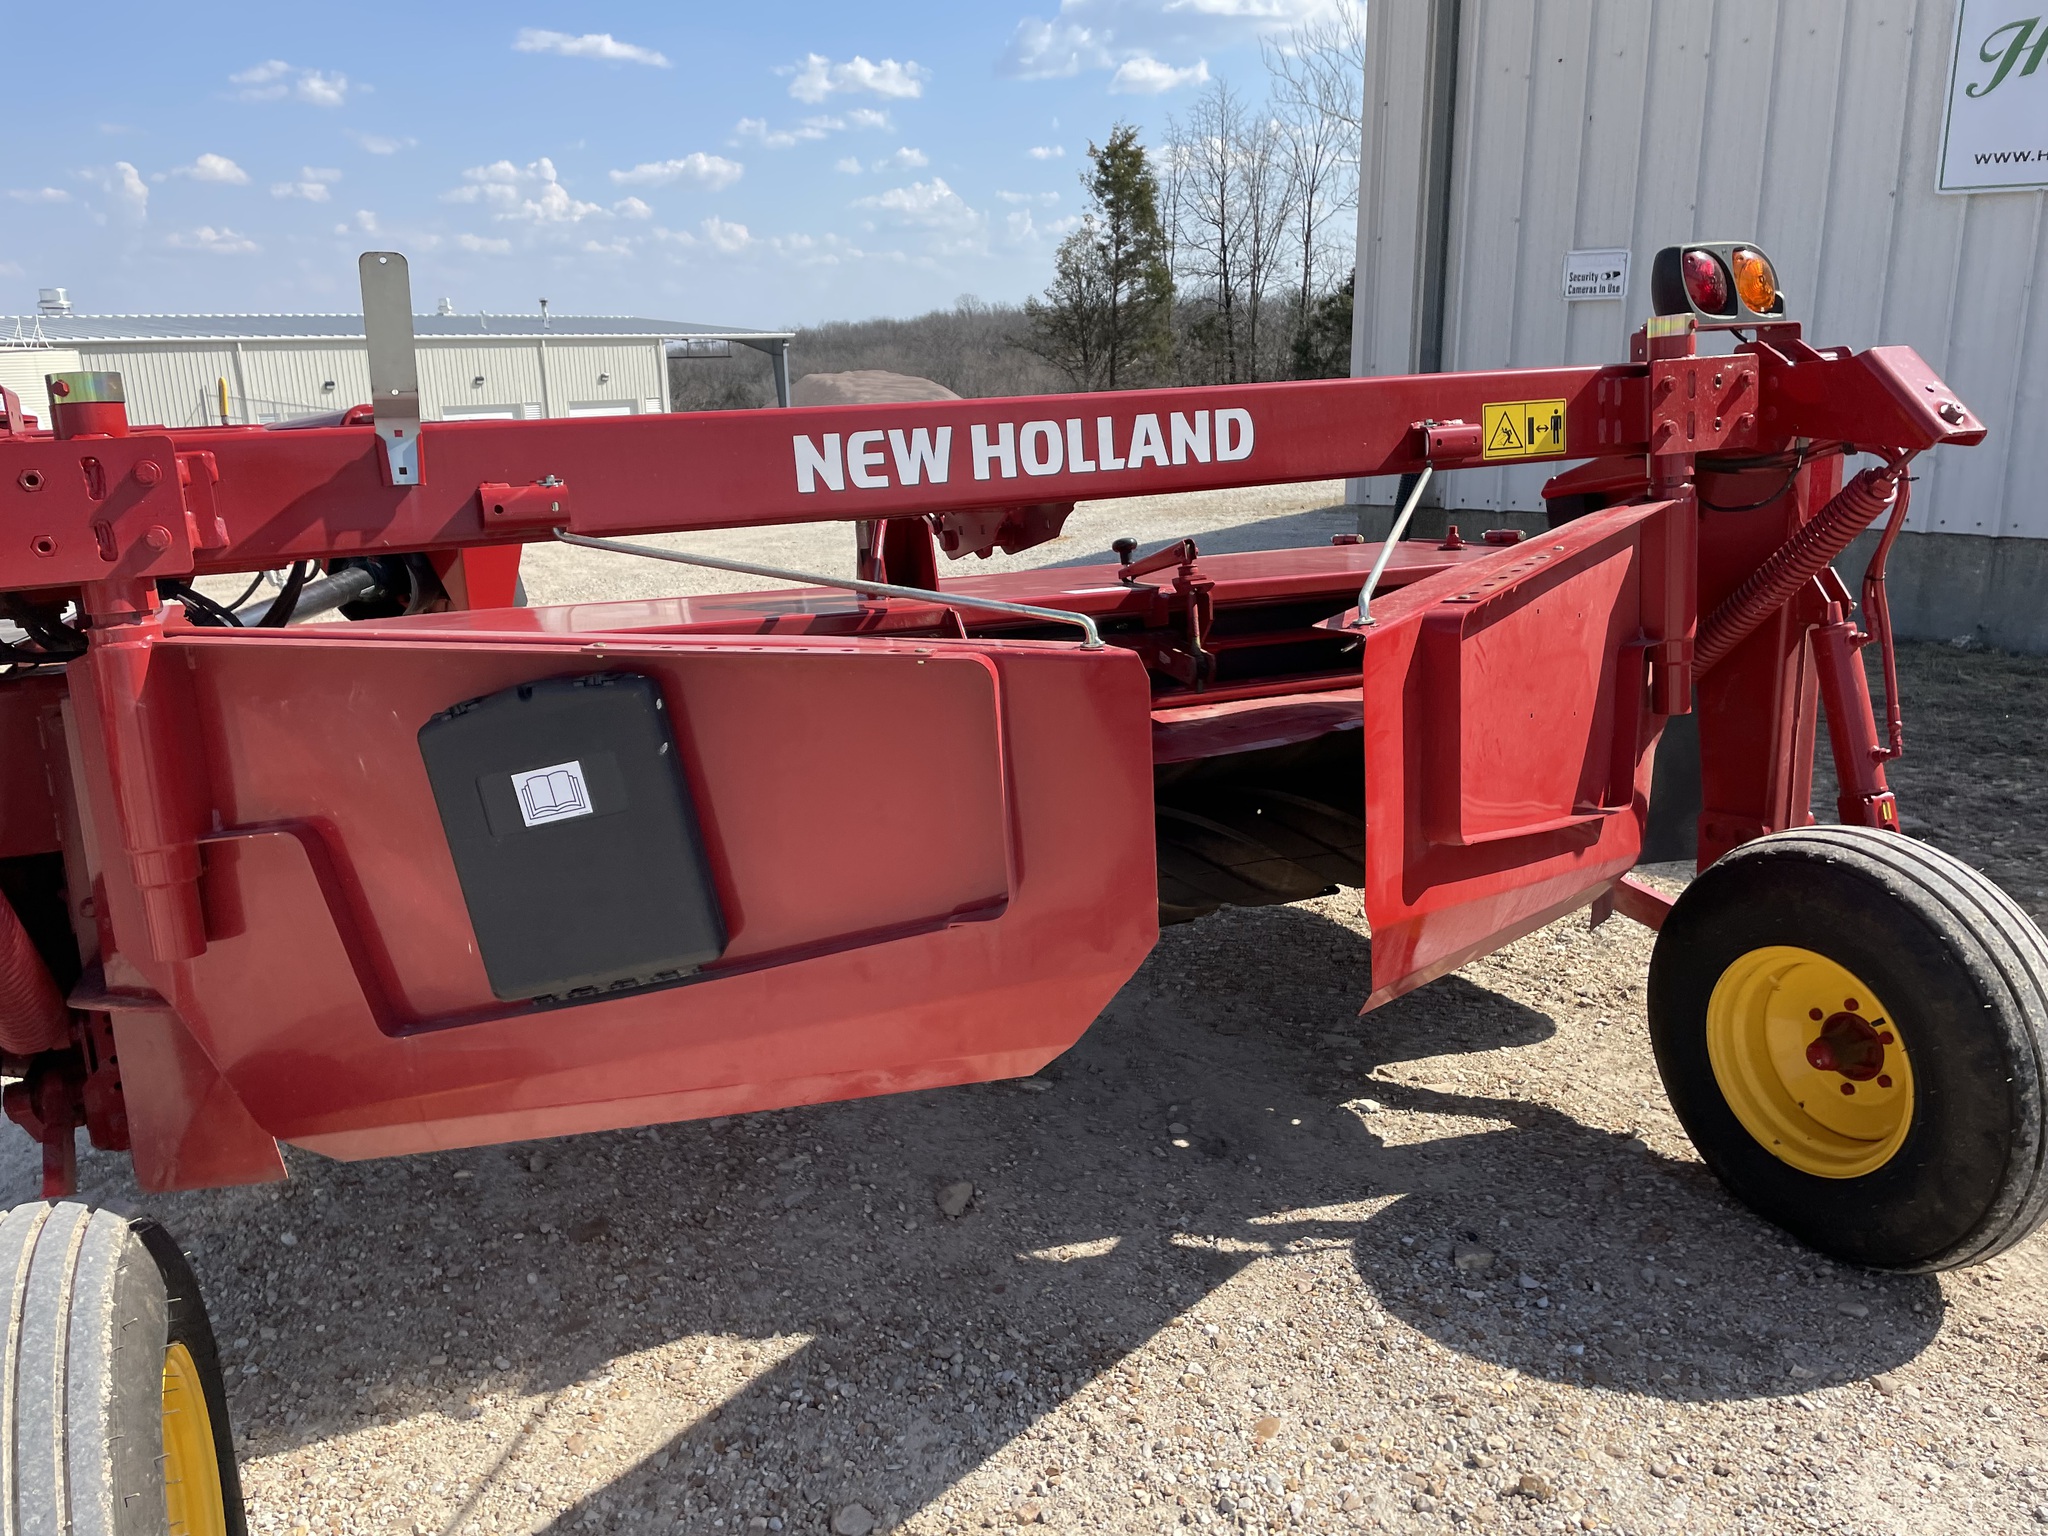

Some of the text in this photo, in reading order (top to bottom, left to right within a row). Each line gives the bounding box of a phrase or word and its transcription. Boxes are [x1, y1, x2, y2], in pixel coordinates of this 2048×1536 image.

[1569, 272, 1599, 283] Security
[1568, 284, 1620, 294] Cameras In Use
[793, 408, 1254, 493] NEW HOLLAND
